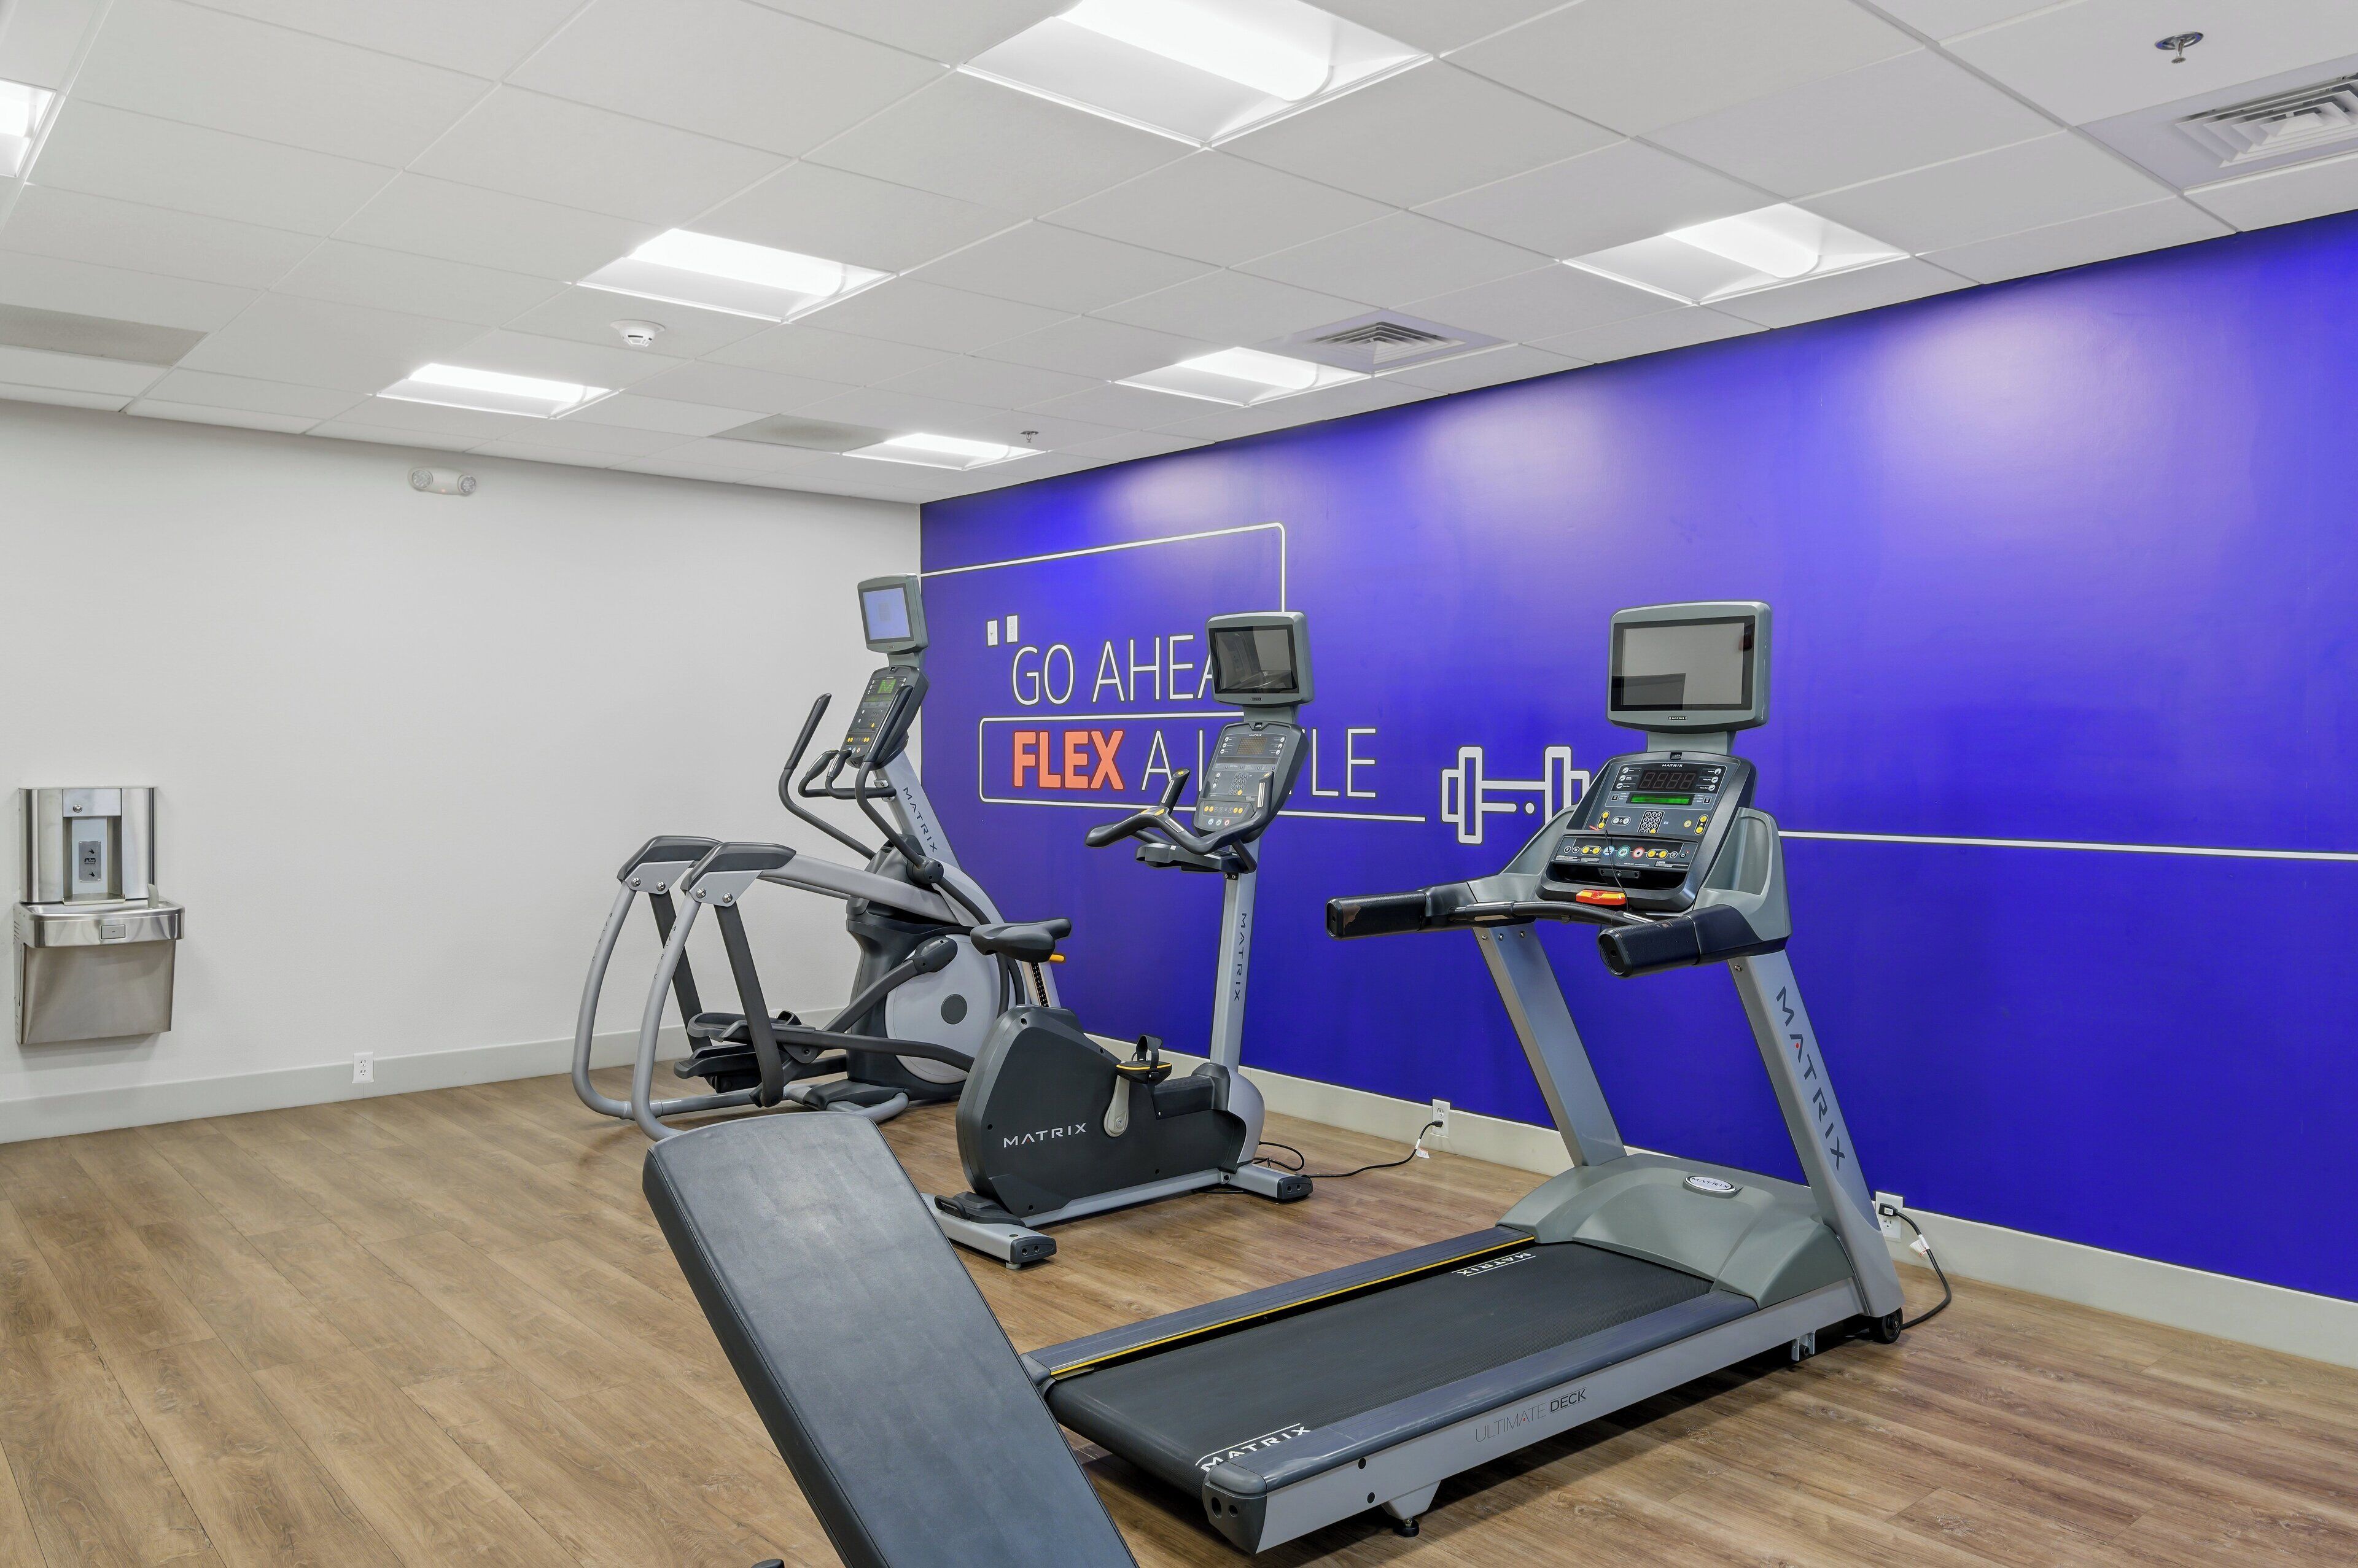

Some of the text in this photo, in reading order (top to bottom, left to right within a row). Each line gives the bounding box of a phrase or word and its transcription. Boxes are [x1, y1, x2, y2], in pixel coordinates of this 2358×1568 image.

[1013, 644, 1074, 705] GO
[1014, 729, 1124, 790] FLEX
[1142, 730, 1174, 791] A
[903, 786, 938, 853] MATRIX
[1234, 913, 1247, 1001] MATRIX
[1776, 985, 1846, 1171] MATRIX
[1003, 1122, 1087, 1149] MATRIX
[1691, 1177, 1730, 1189] MATRIX
[1456, 1252, 1531, 1275] MATRIX
[1476, 1388, 1587, 1443] ULTIMATE DECK
[1200, 1426, 1312, 1473] MATRIX
